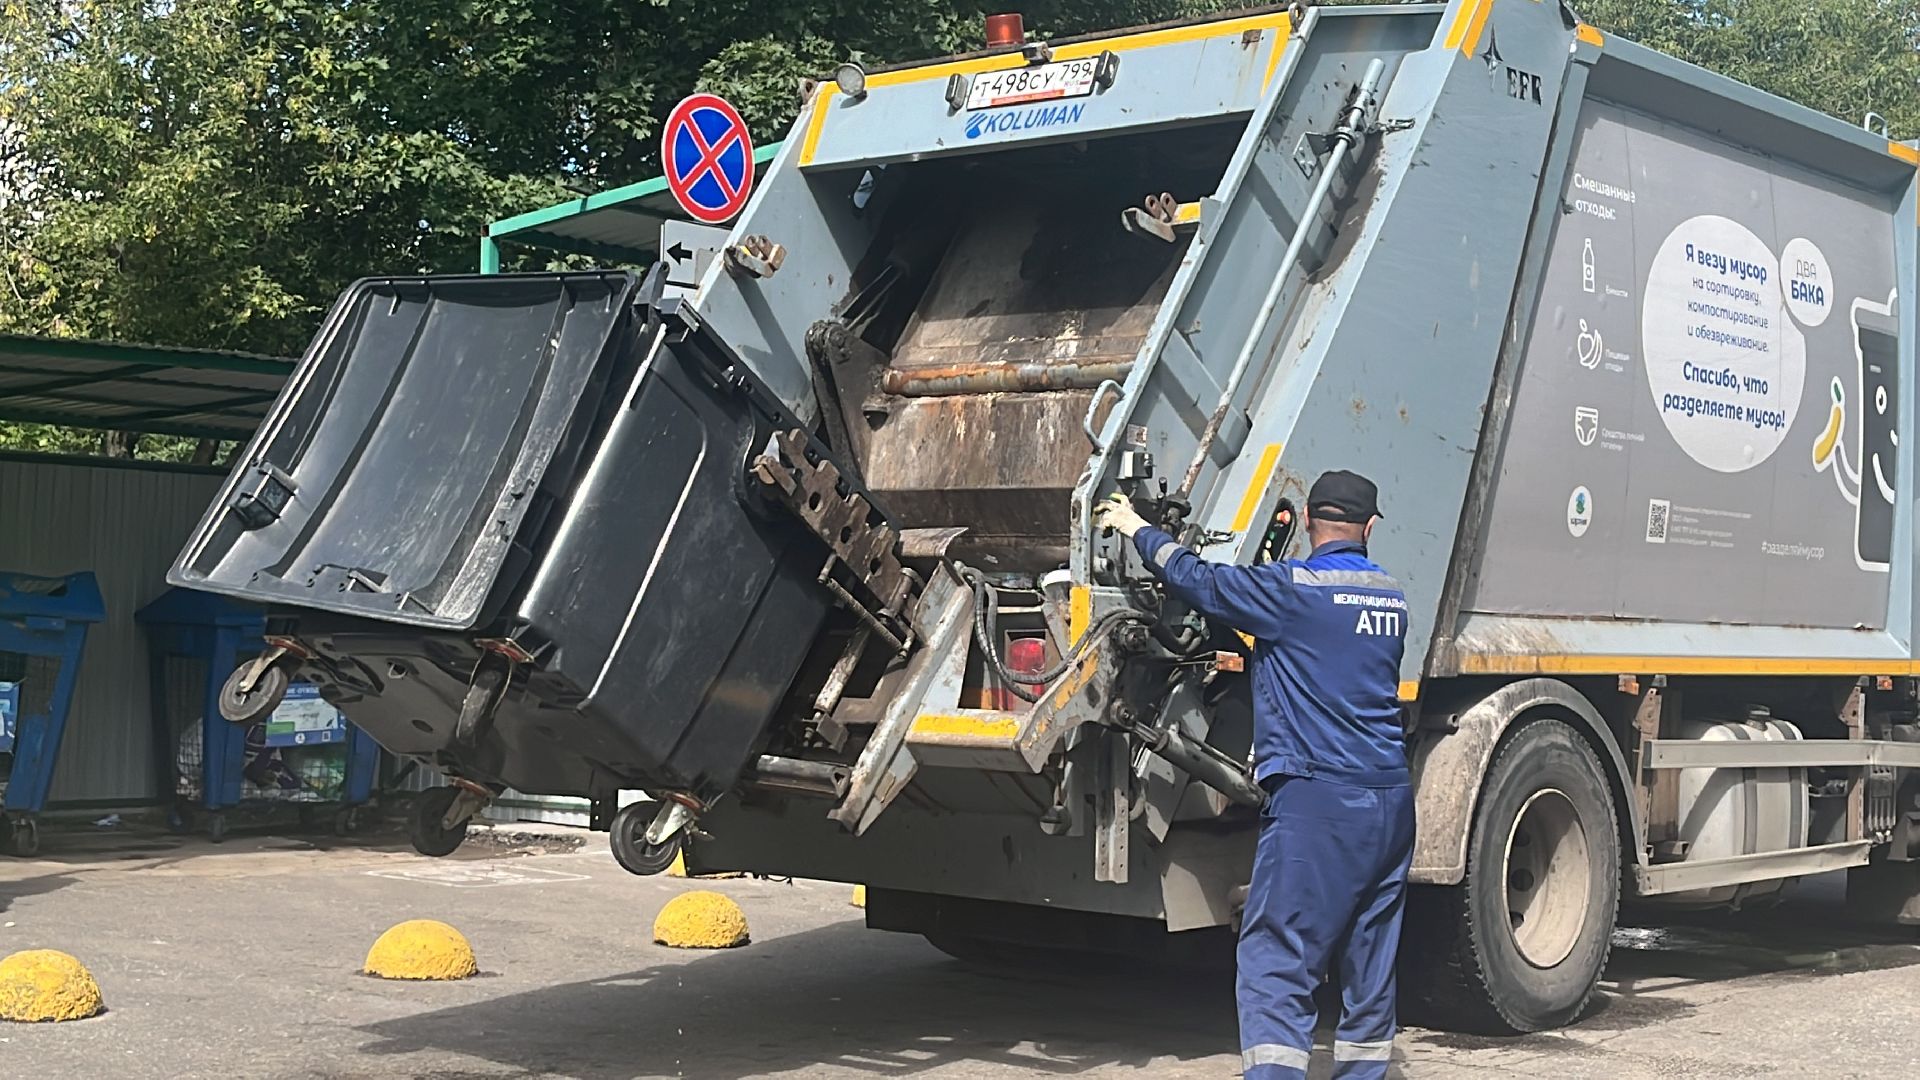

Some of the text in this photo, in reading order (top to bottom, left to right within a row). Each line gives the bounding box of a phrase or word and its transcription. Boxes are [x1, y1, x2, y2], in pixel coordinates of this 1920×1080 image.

[984, 103, 1086, 134] KOLUMAN
[1574, 172, 1636, 203] Смешанные
[1575, 199, 1616, 220] отходы:
[1685, 243, 1767, 285] Я везу мусор
[1796, 259, 1817, 280] ДВА
[1692, 276, 1762, 306] на сортировку,
[1790, 279, 1825, 307] БАКА
[1687, 300, 1769, 329] компостирование
[1687, 324, 1770, 352] и обезвреживание.
[1683, 361, 1768, 395] Спасибо, что
[1663, 393, 1785, 431] разделяете мусор!
[1355, 609, 1399, 637] АТП
